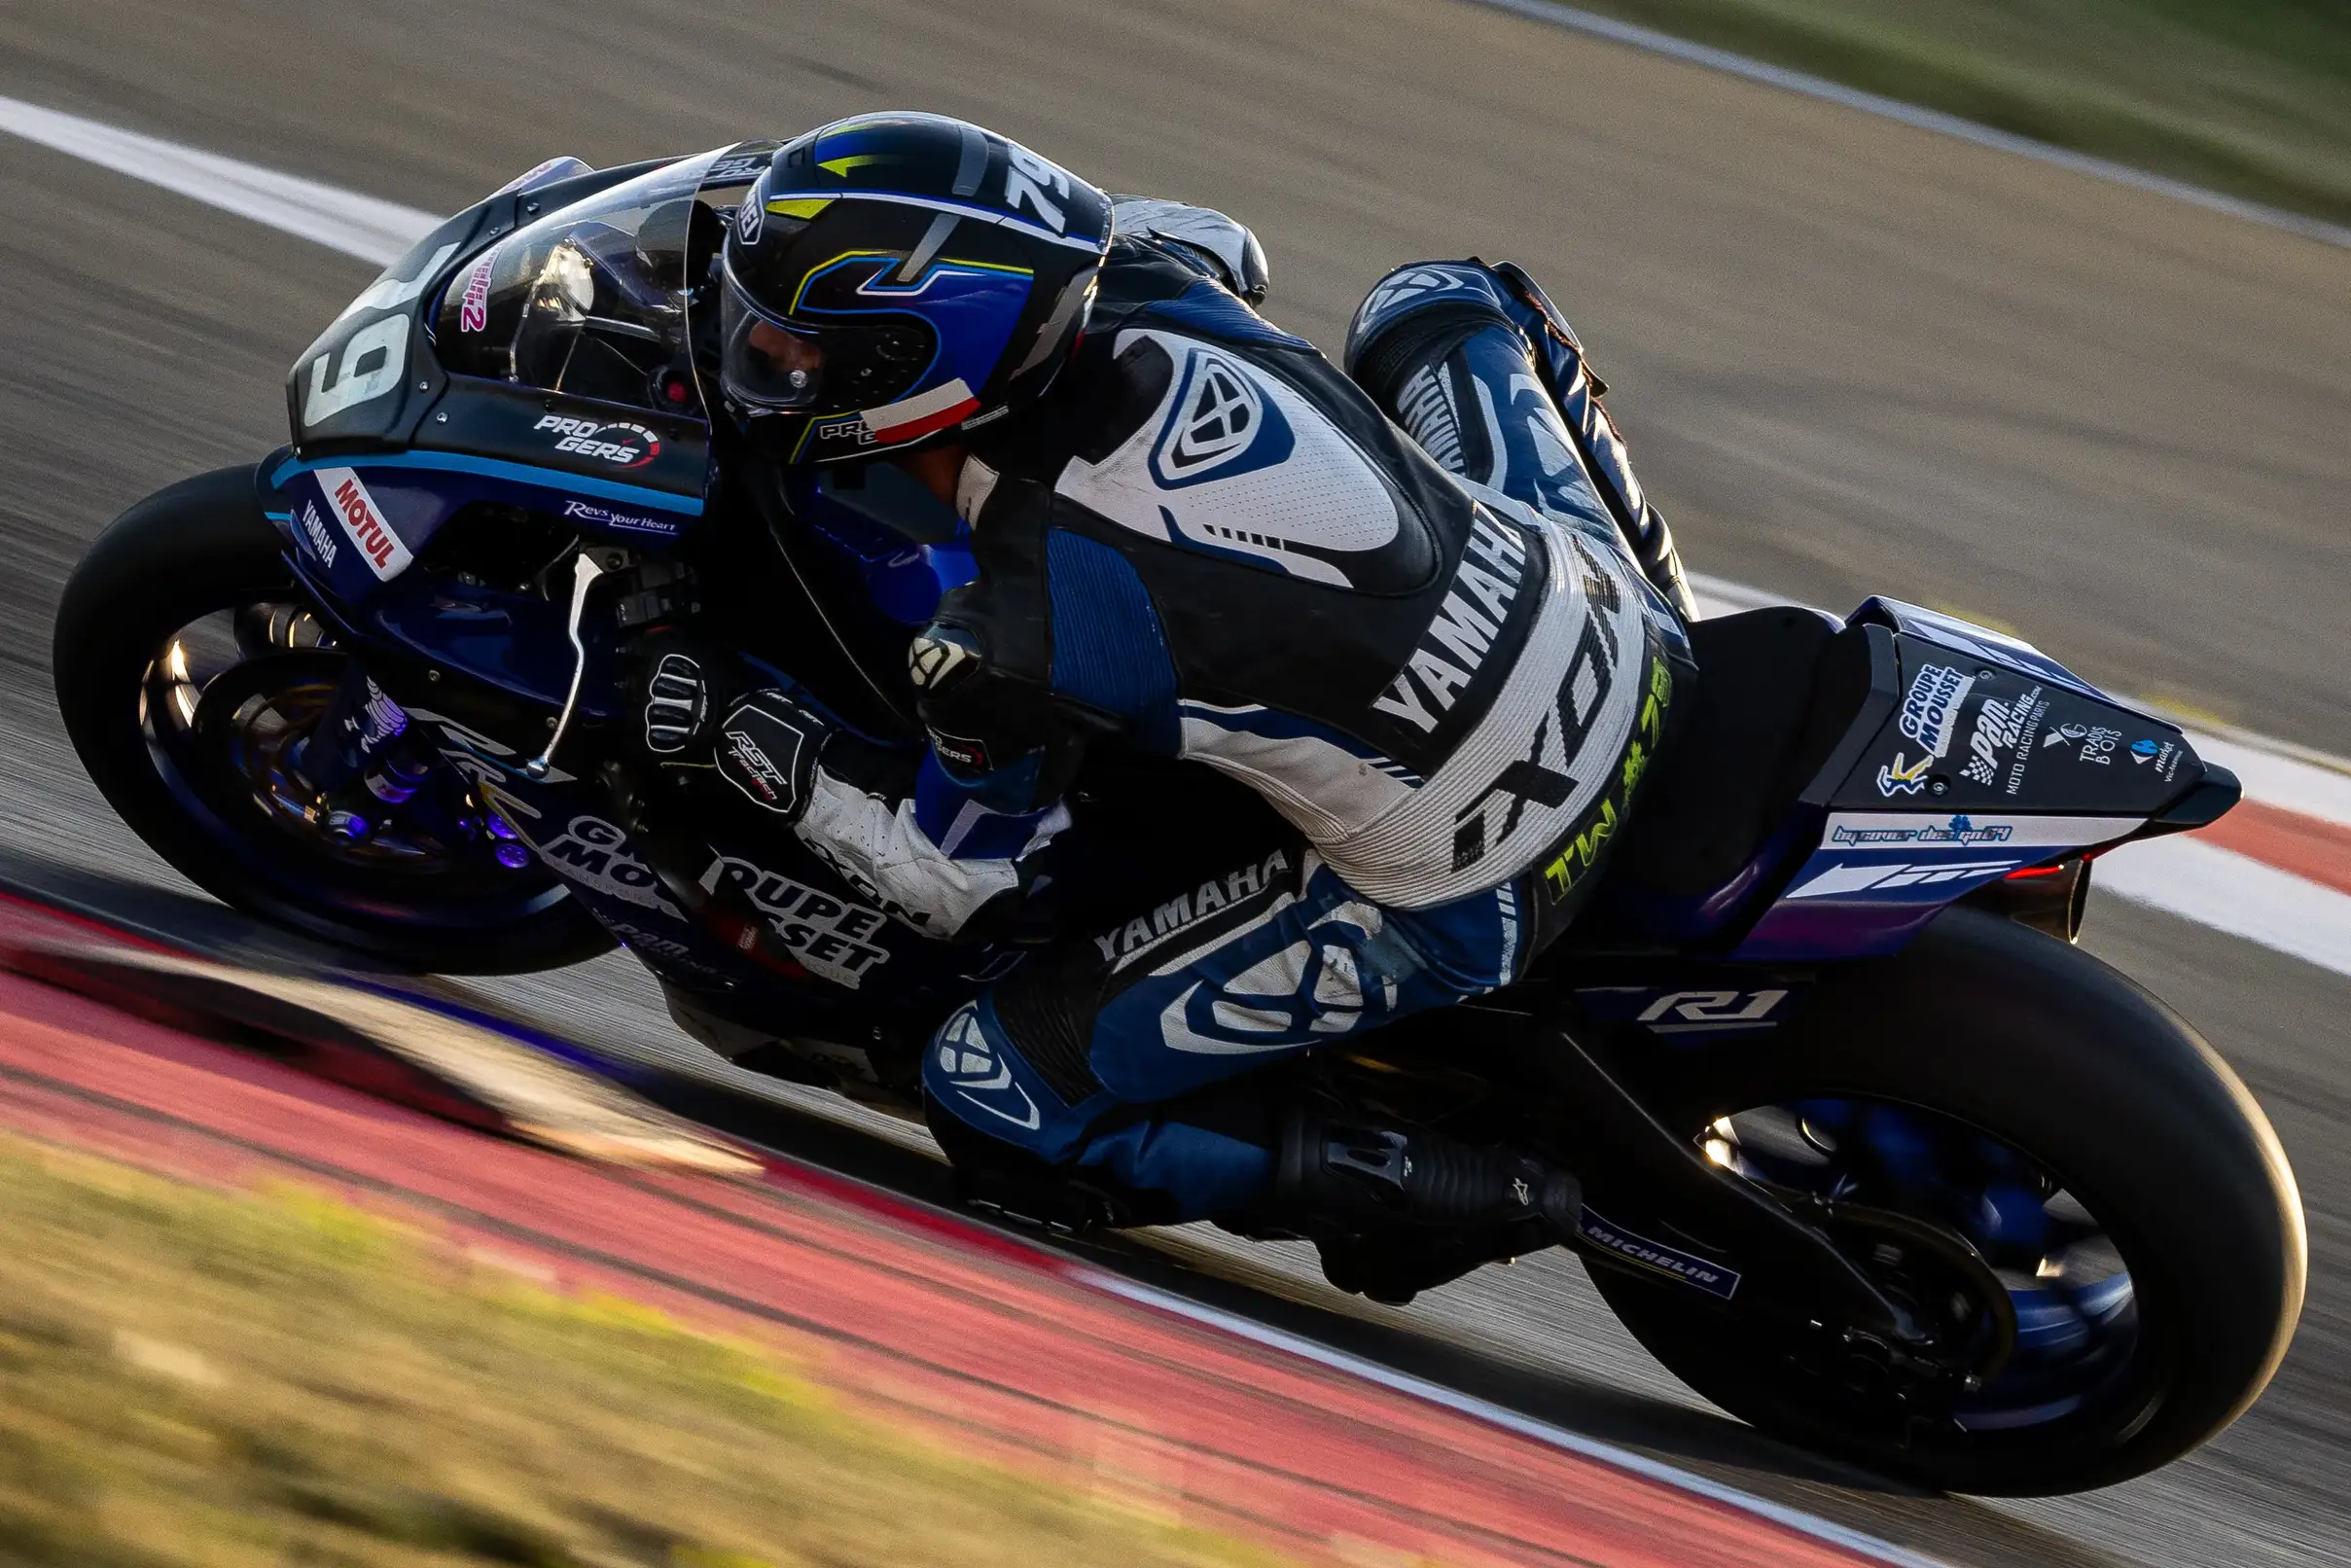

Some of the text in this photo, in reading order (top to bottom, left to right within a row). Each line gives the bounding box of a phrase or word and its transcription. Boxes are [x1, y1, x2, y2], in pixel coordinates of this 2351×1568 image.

[534, 415, 598, 438] PRO
[554, 437, 640, 463] GERS
[303, 499, 338, 569] YAMAHA
[334, 479, 395, 569] MOTUL
[563, 500, 612, 520] Revs
[1451, 532, 1621, 873] IXON
[1901, 664, 1944, 737] GROUPE
[1919, 667, 1965, 753] MOUSSET
[725, 731, 789, 785] RST
[2015, 720, 2040, 761] RACING
[2094, 730, 2122, 766] BOIS
[2006, 764, 2025, 795] MOTO
[1093, 848, 1289, 962] YAMAHA
[1636, 988, 1790, 1022] R1
[1586, 1226, 1720, 1284] MICHELIN
